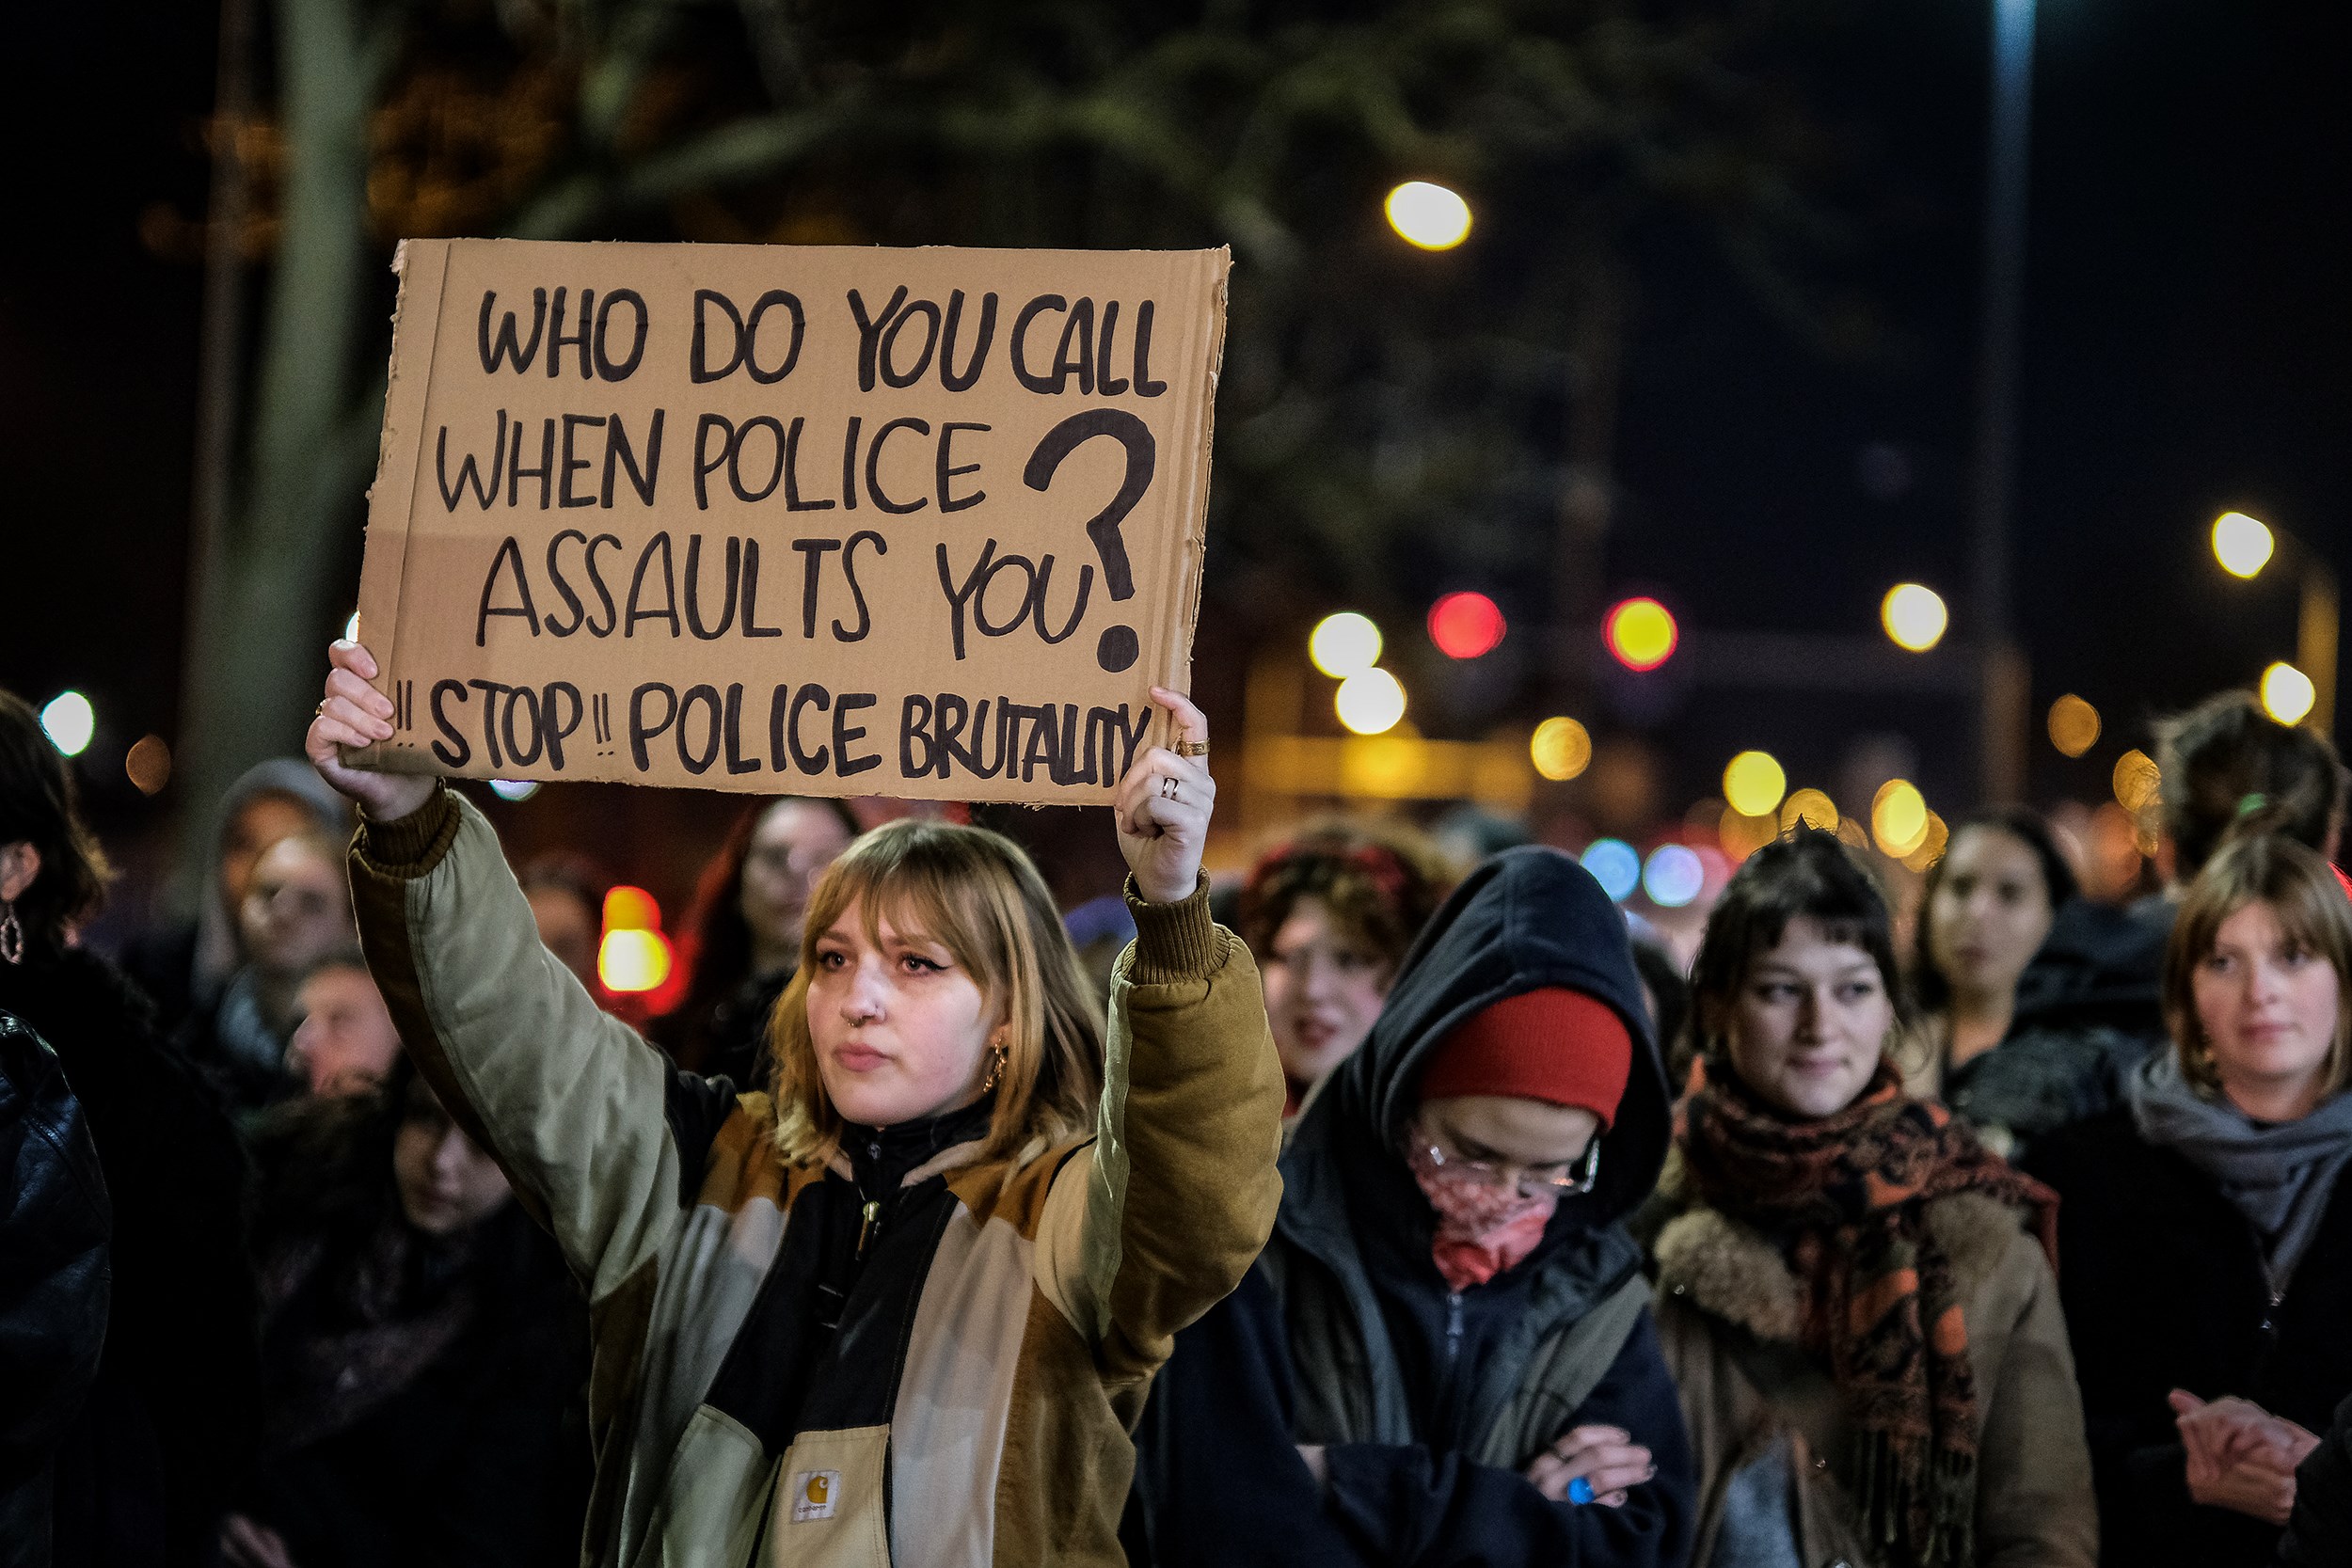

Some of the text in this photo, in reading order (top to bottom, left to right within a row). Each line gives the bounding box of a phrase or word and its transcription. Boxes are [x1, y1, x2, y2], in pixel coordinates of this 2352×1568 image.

[478, 284, 1168, 398] WHO DO YOU CALL
[436, 407, 993, 515] WHEN POLICE
[475, 529, 888, 649] ASSAULTS
[628, 682, 882, 779] POLICE
[898, 692, 1152, 789] BRUTALITY
